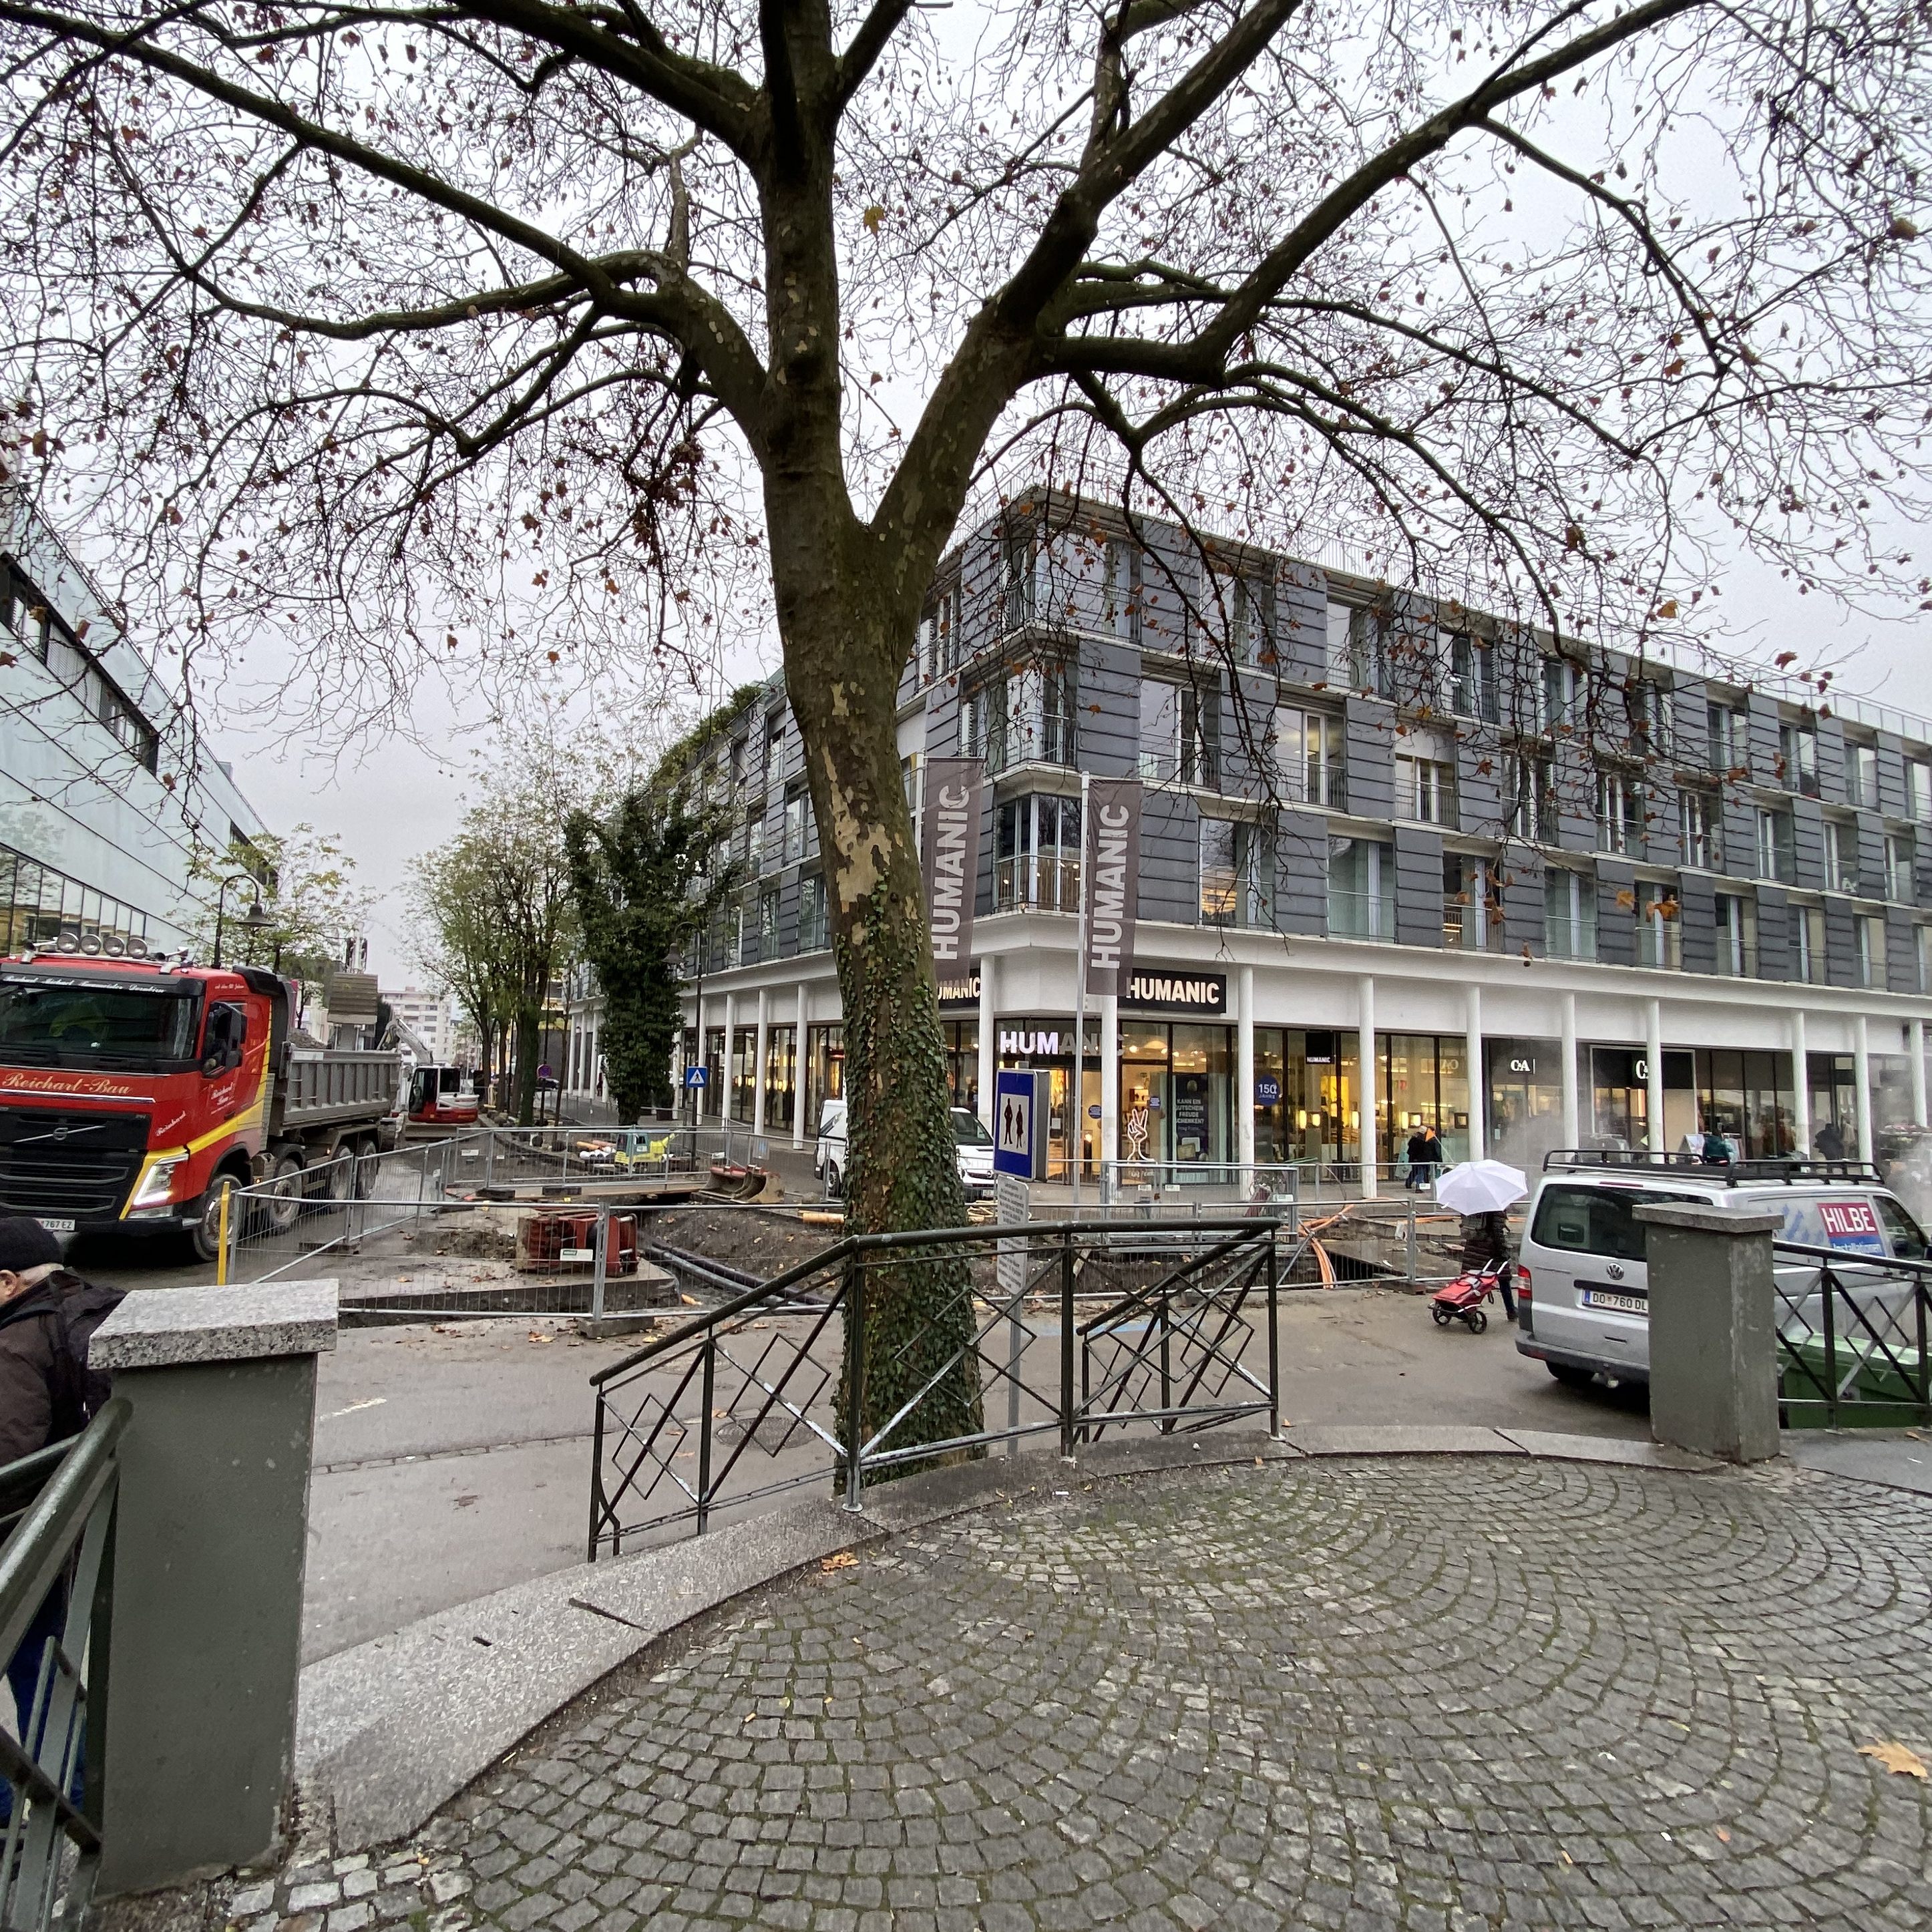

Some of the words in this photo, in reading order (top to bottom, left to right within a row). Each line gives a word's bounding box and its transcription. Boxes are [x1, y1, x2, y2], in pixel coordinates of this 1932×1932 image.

[931, 785, 969, 960] HUMANIC
[1091, 805, 1129, 969] HUMANIC
[1126, 977, 1219, 1004] HUMANIC
[2, 1072, 132, 1095] Reichart-Bau
[1821, 1207, 1876, 1233] HILBE
